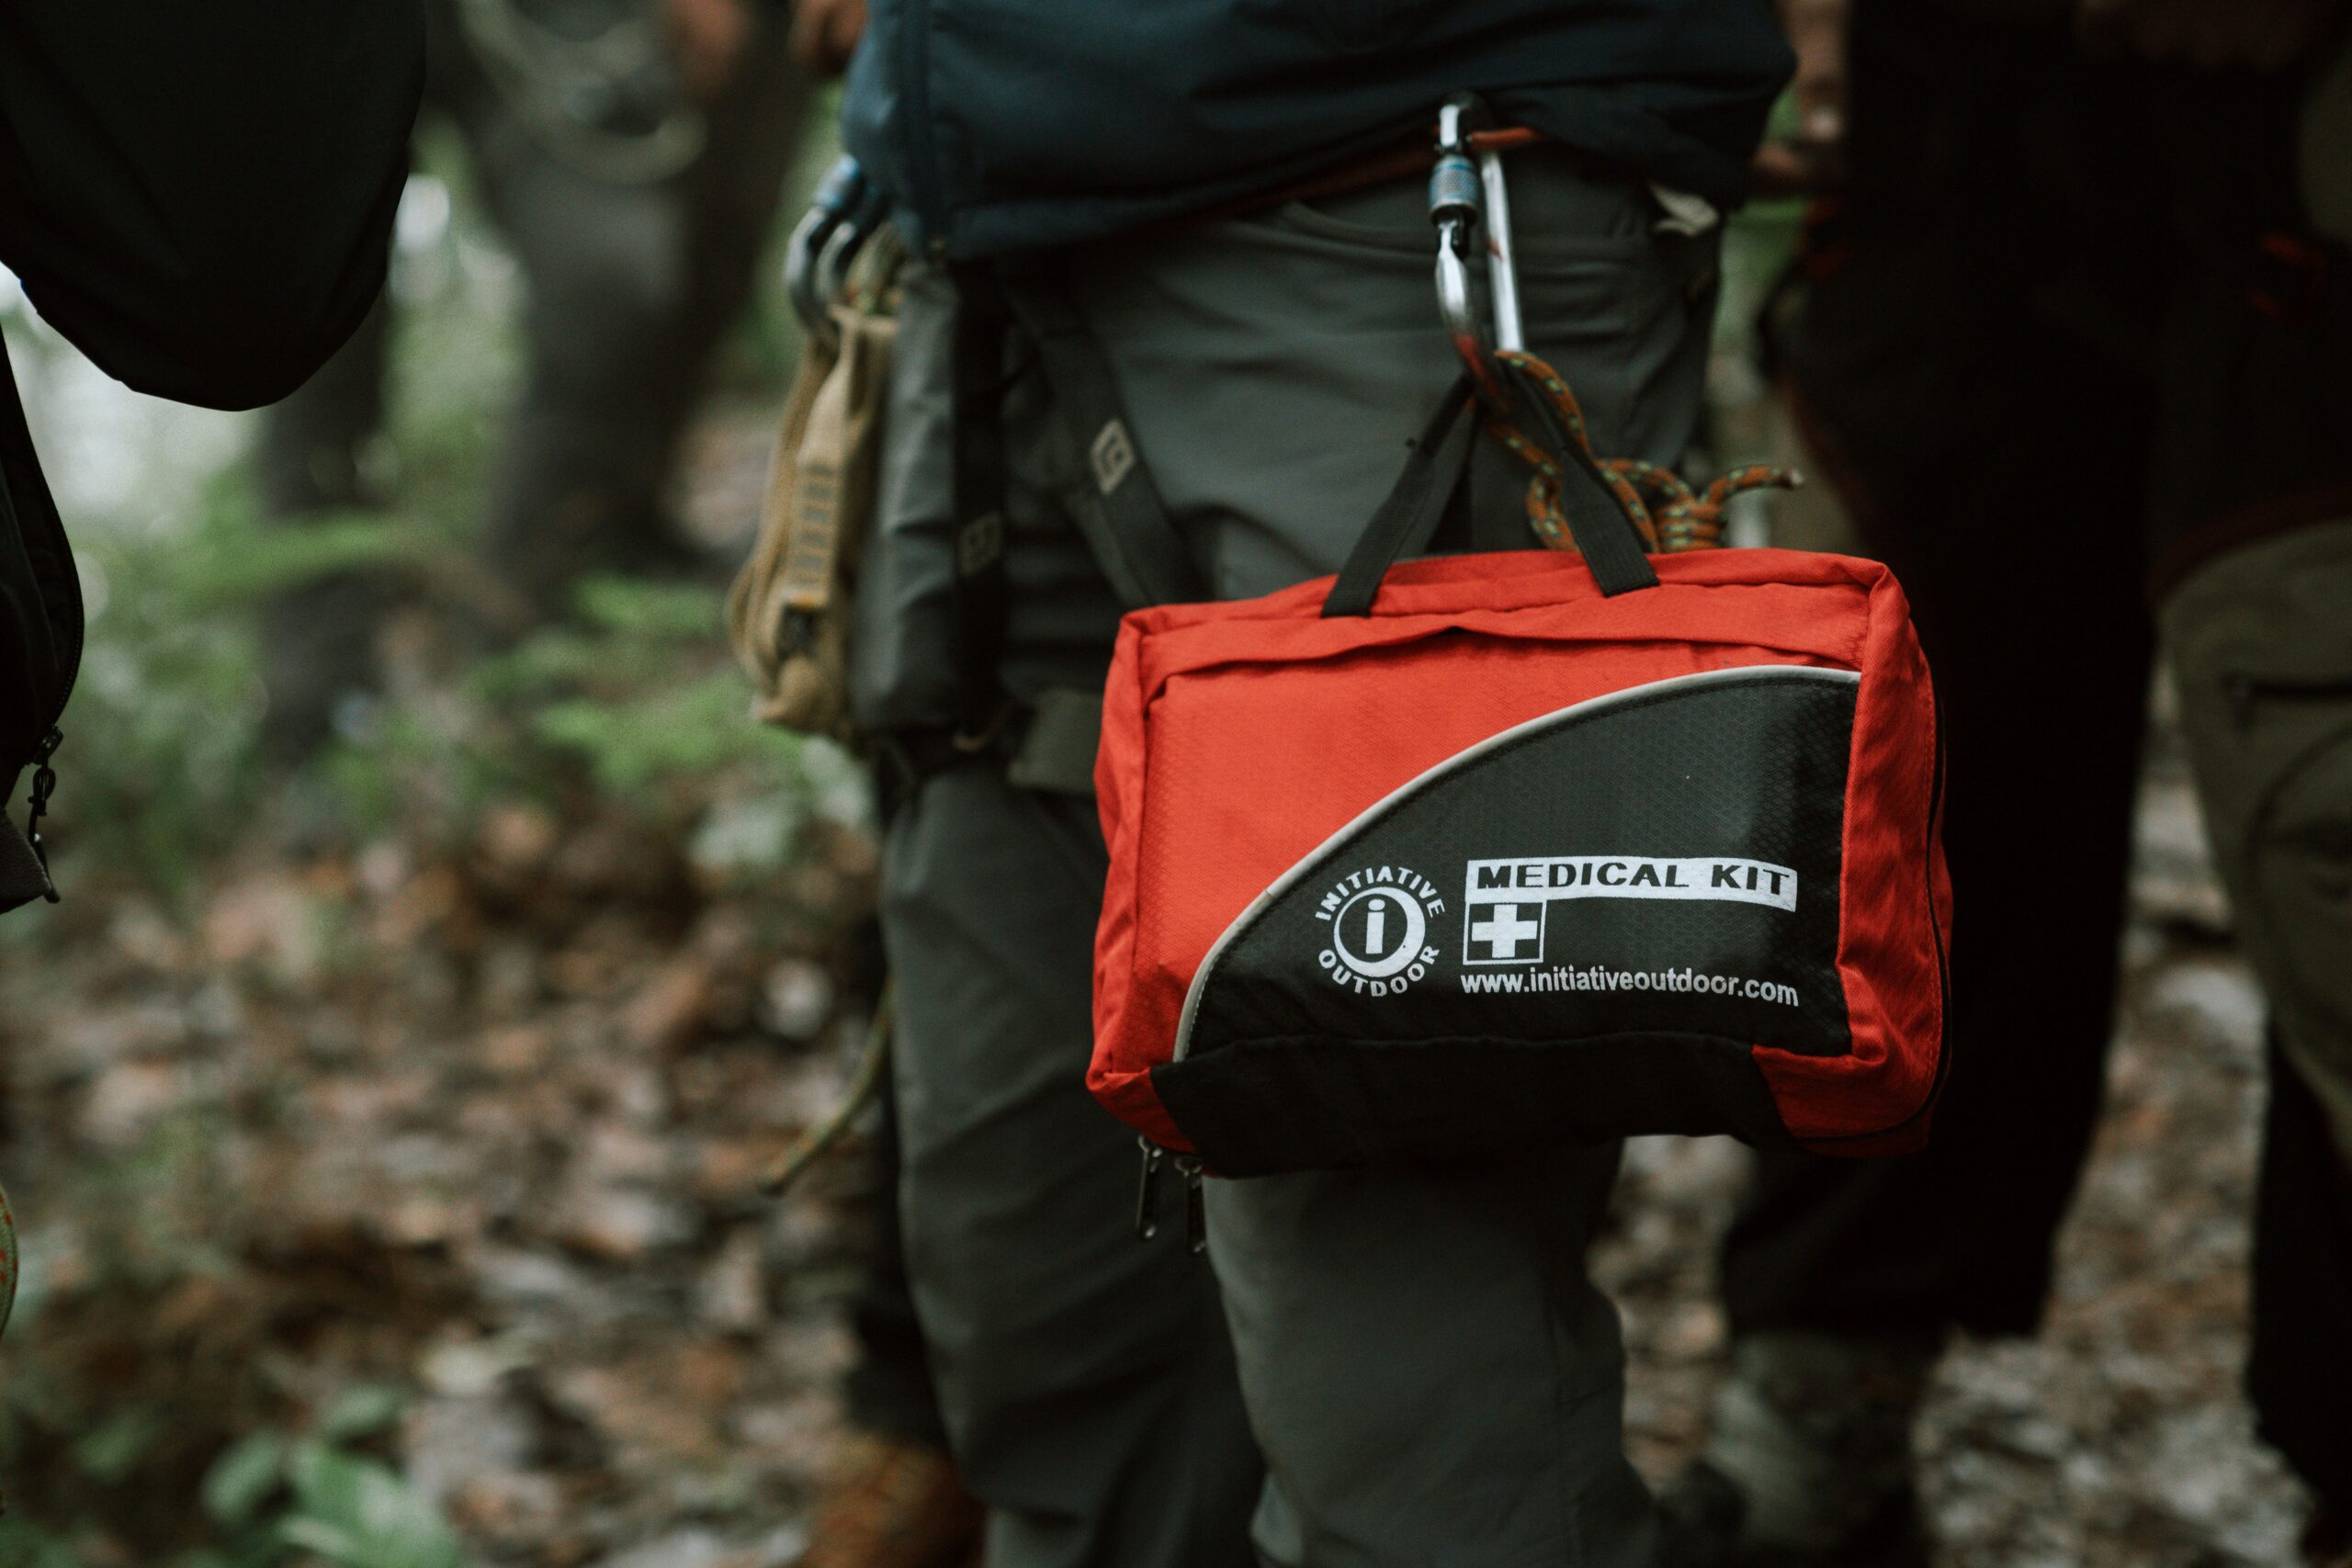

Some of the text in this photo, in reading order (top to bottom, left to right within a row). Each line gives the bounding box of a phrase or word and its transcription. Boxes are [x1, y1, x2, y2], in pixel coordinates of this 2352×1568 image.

[1315, 865, 1445, 920] INITIATIVE
[1476, 861, 1791, 896] MEDICAL KIT
[1365, 898, 1385, 954] i
[1318, 945, 1440, 997] OUTDOOR
[1460, 965, 1799, 1007] www.initiativeoutdoor.com
